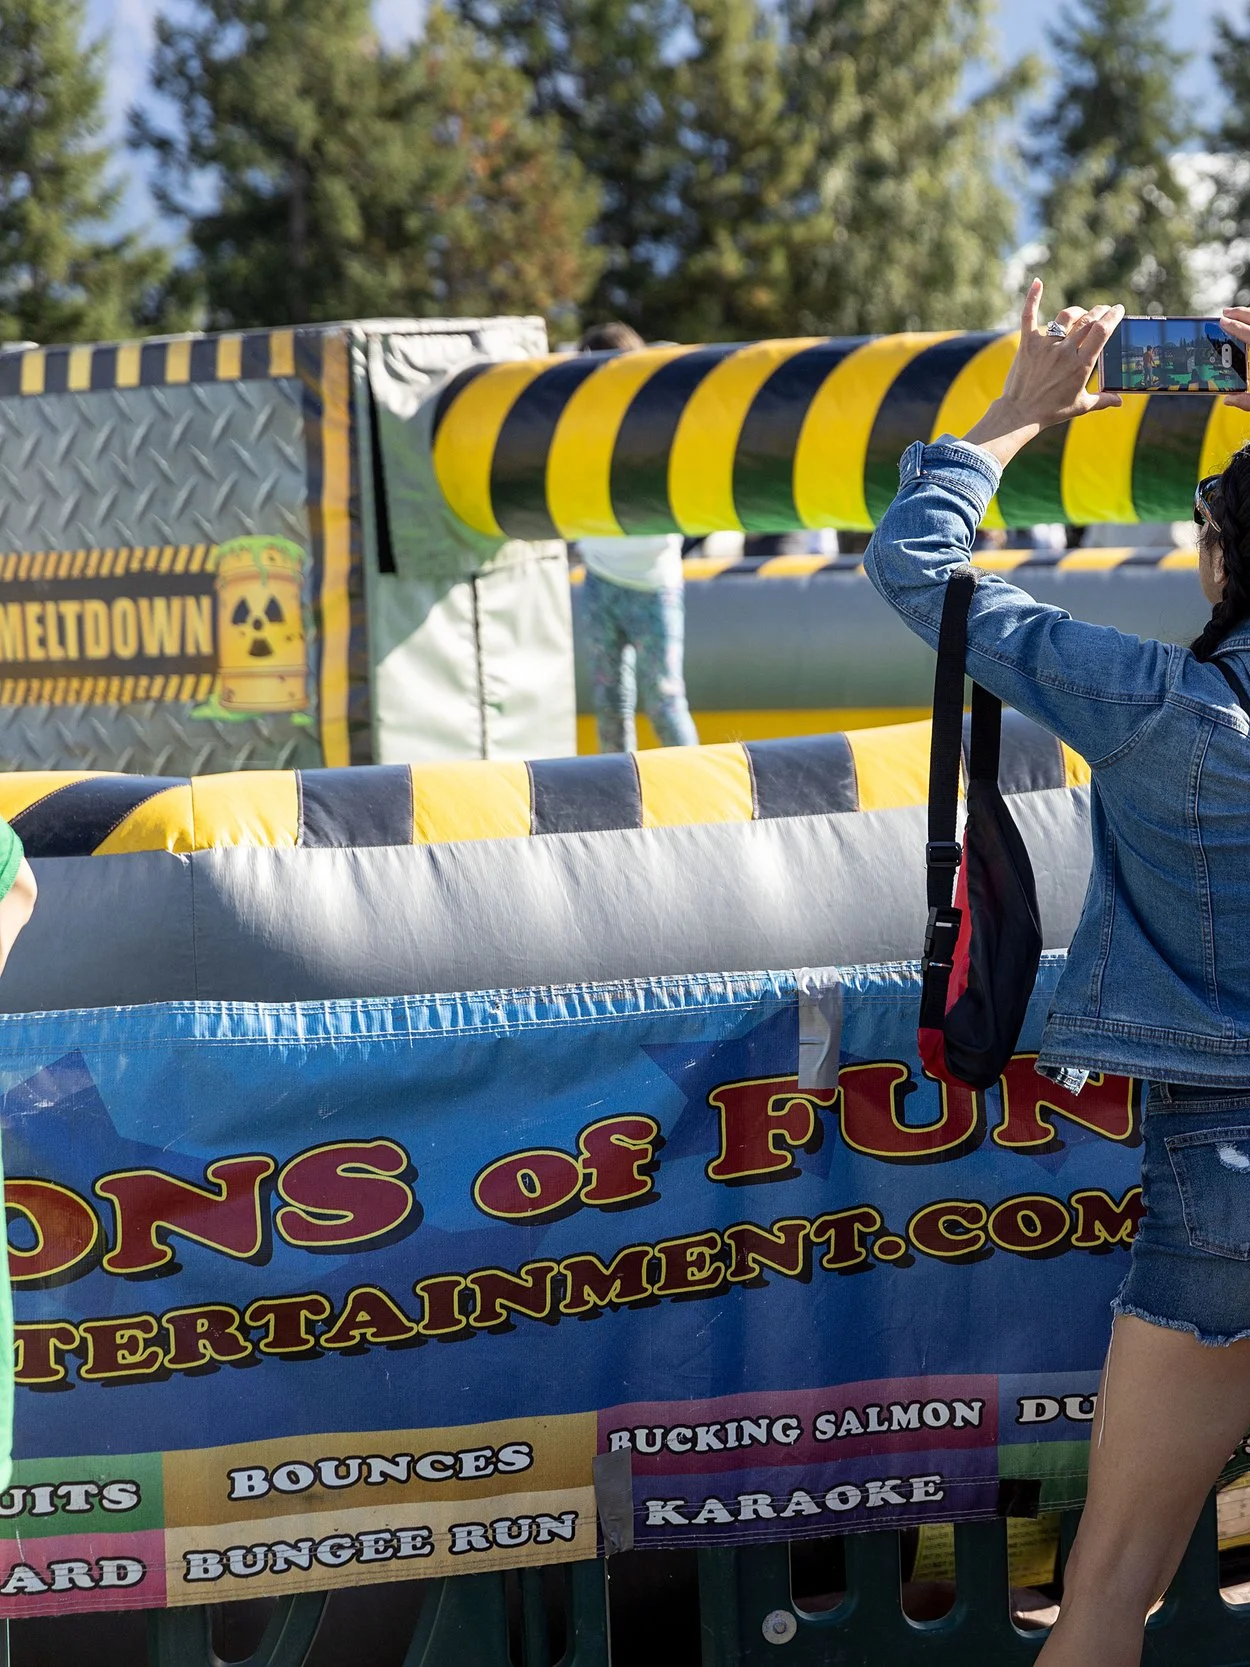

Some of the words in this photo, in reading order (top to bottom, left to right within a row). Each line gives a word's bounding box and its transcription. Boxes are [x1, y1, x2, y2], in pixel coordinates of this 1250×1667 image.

[0, 594, 213, 662] MELTDOWN
[474, 1115, 658, 1219] of
[706, 1053, 1136, 1181] FUN
[814, 1400, 983, 1441] SALMON
[230, 1443, 534, 1499] BOUNCES
[645, 1474, 945, 1526] KARAOKE
[185, 1526, 432, 1581] BUNGEE
[451, 1512, 578, 1553] RUN
